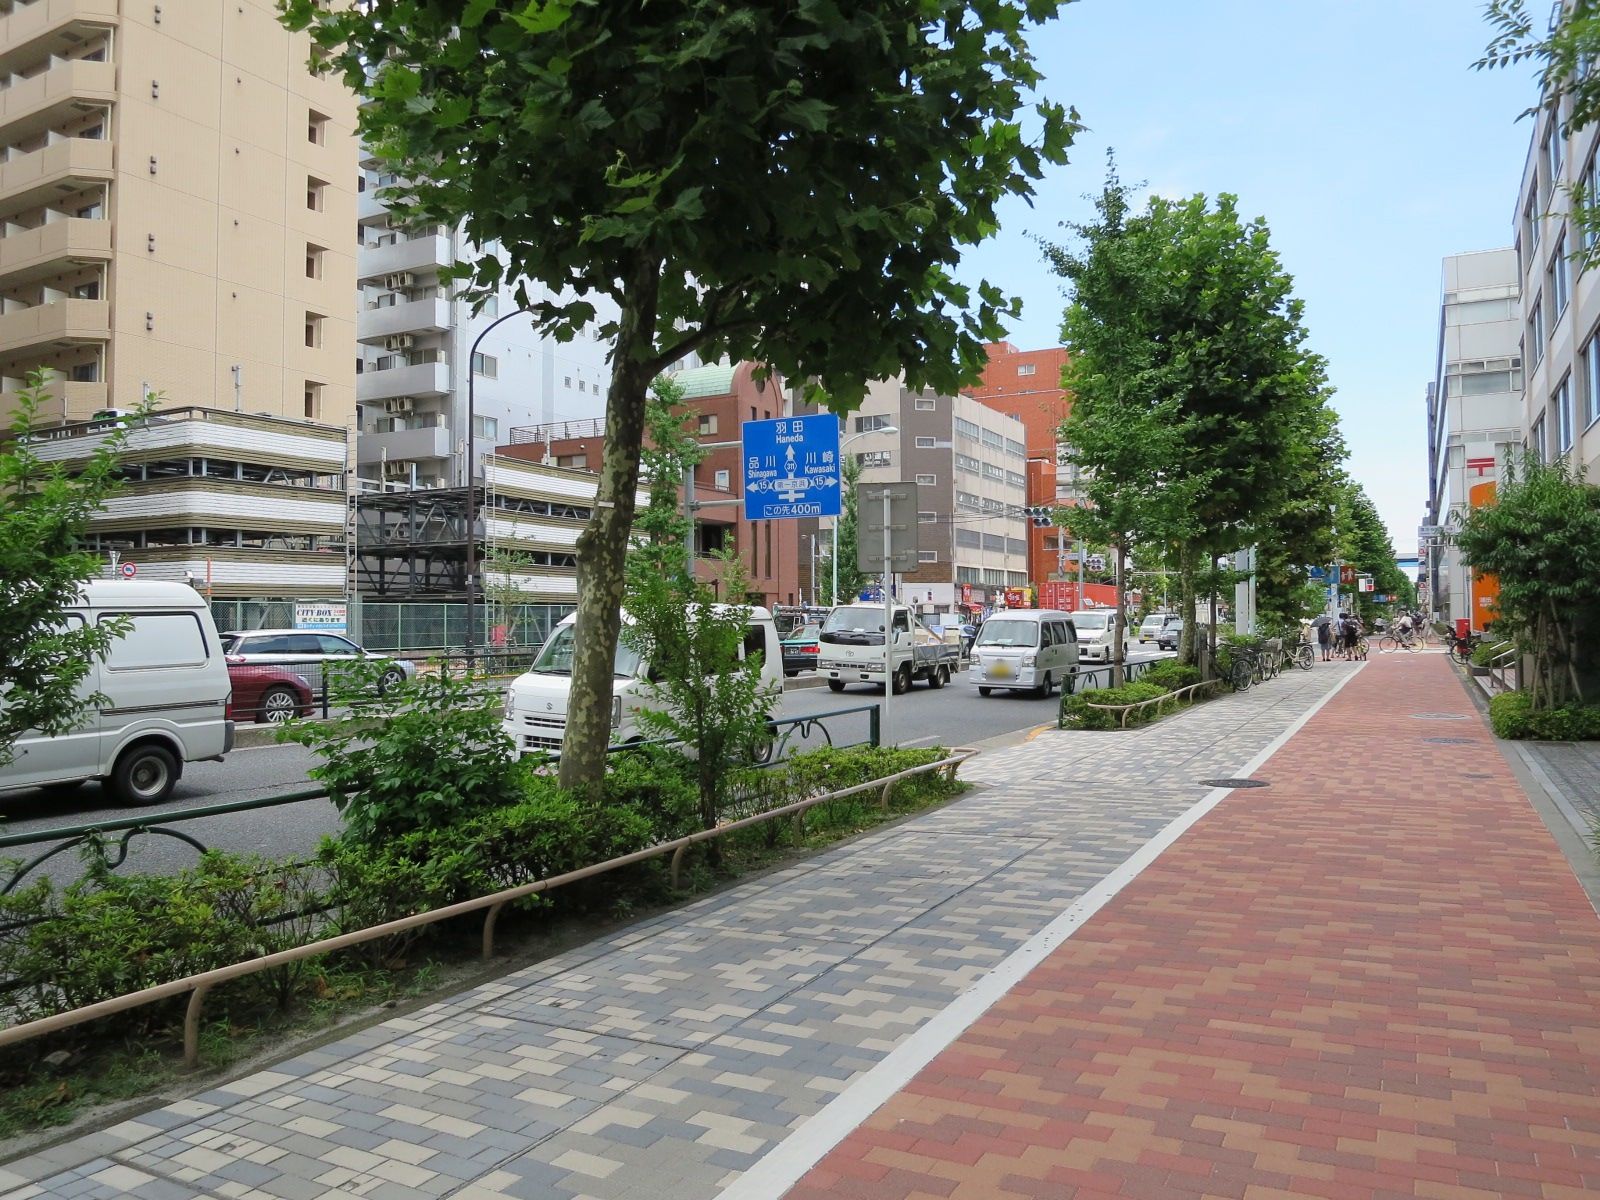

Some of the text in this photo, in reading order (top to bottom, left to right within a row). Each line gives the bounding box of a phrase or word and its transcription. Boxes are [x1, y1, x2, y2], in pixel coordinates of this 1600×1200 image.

[775, 420, 803, 434] 羽田
[776, 434, 803, 444] Haneda
[748, 455, 776, 469] 品川
[805, 451, 834, 464] 川崎
[748, 469, 777, 479] Shinagawa
[804, 463, 836, 474] Kawasaki
[815, 477, 824, 485] 15
